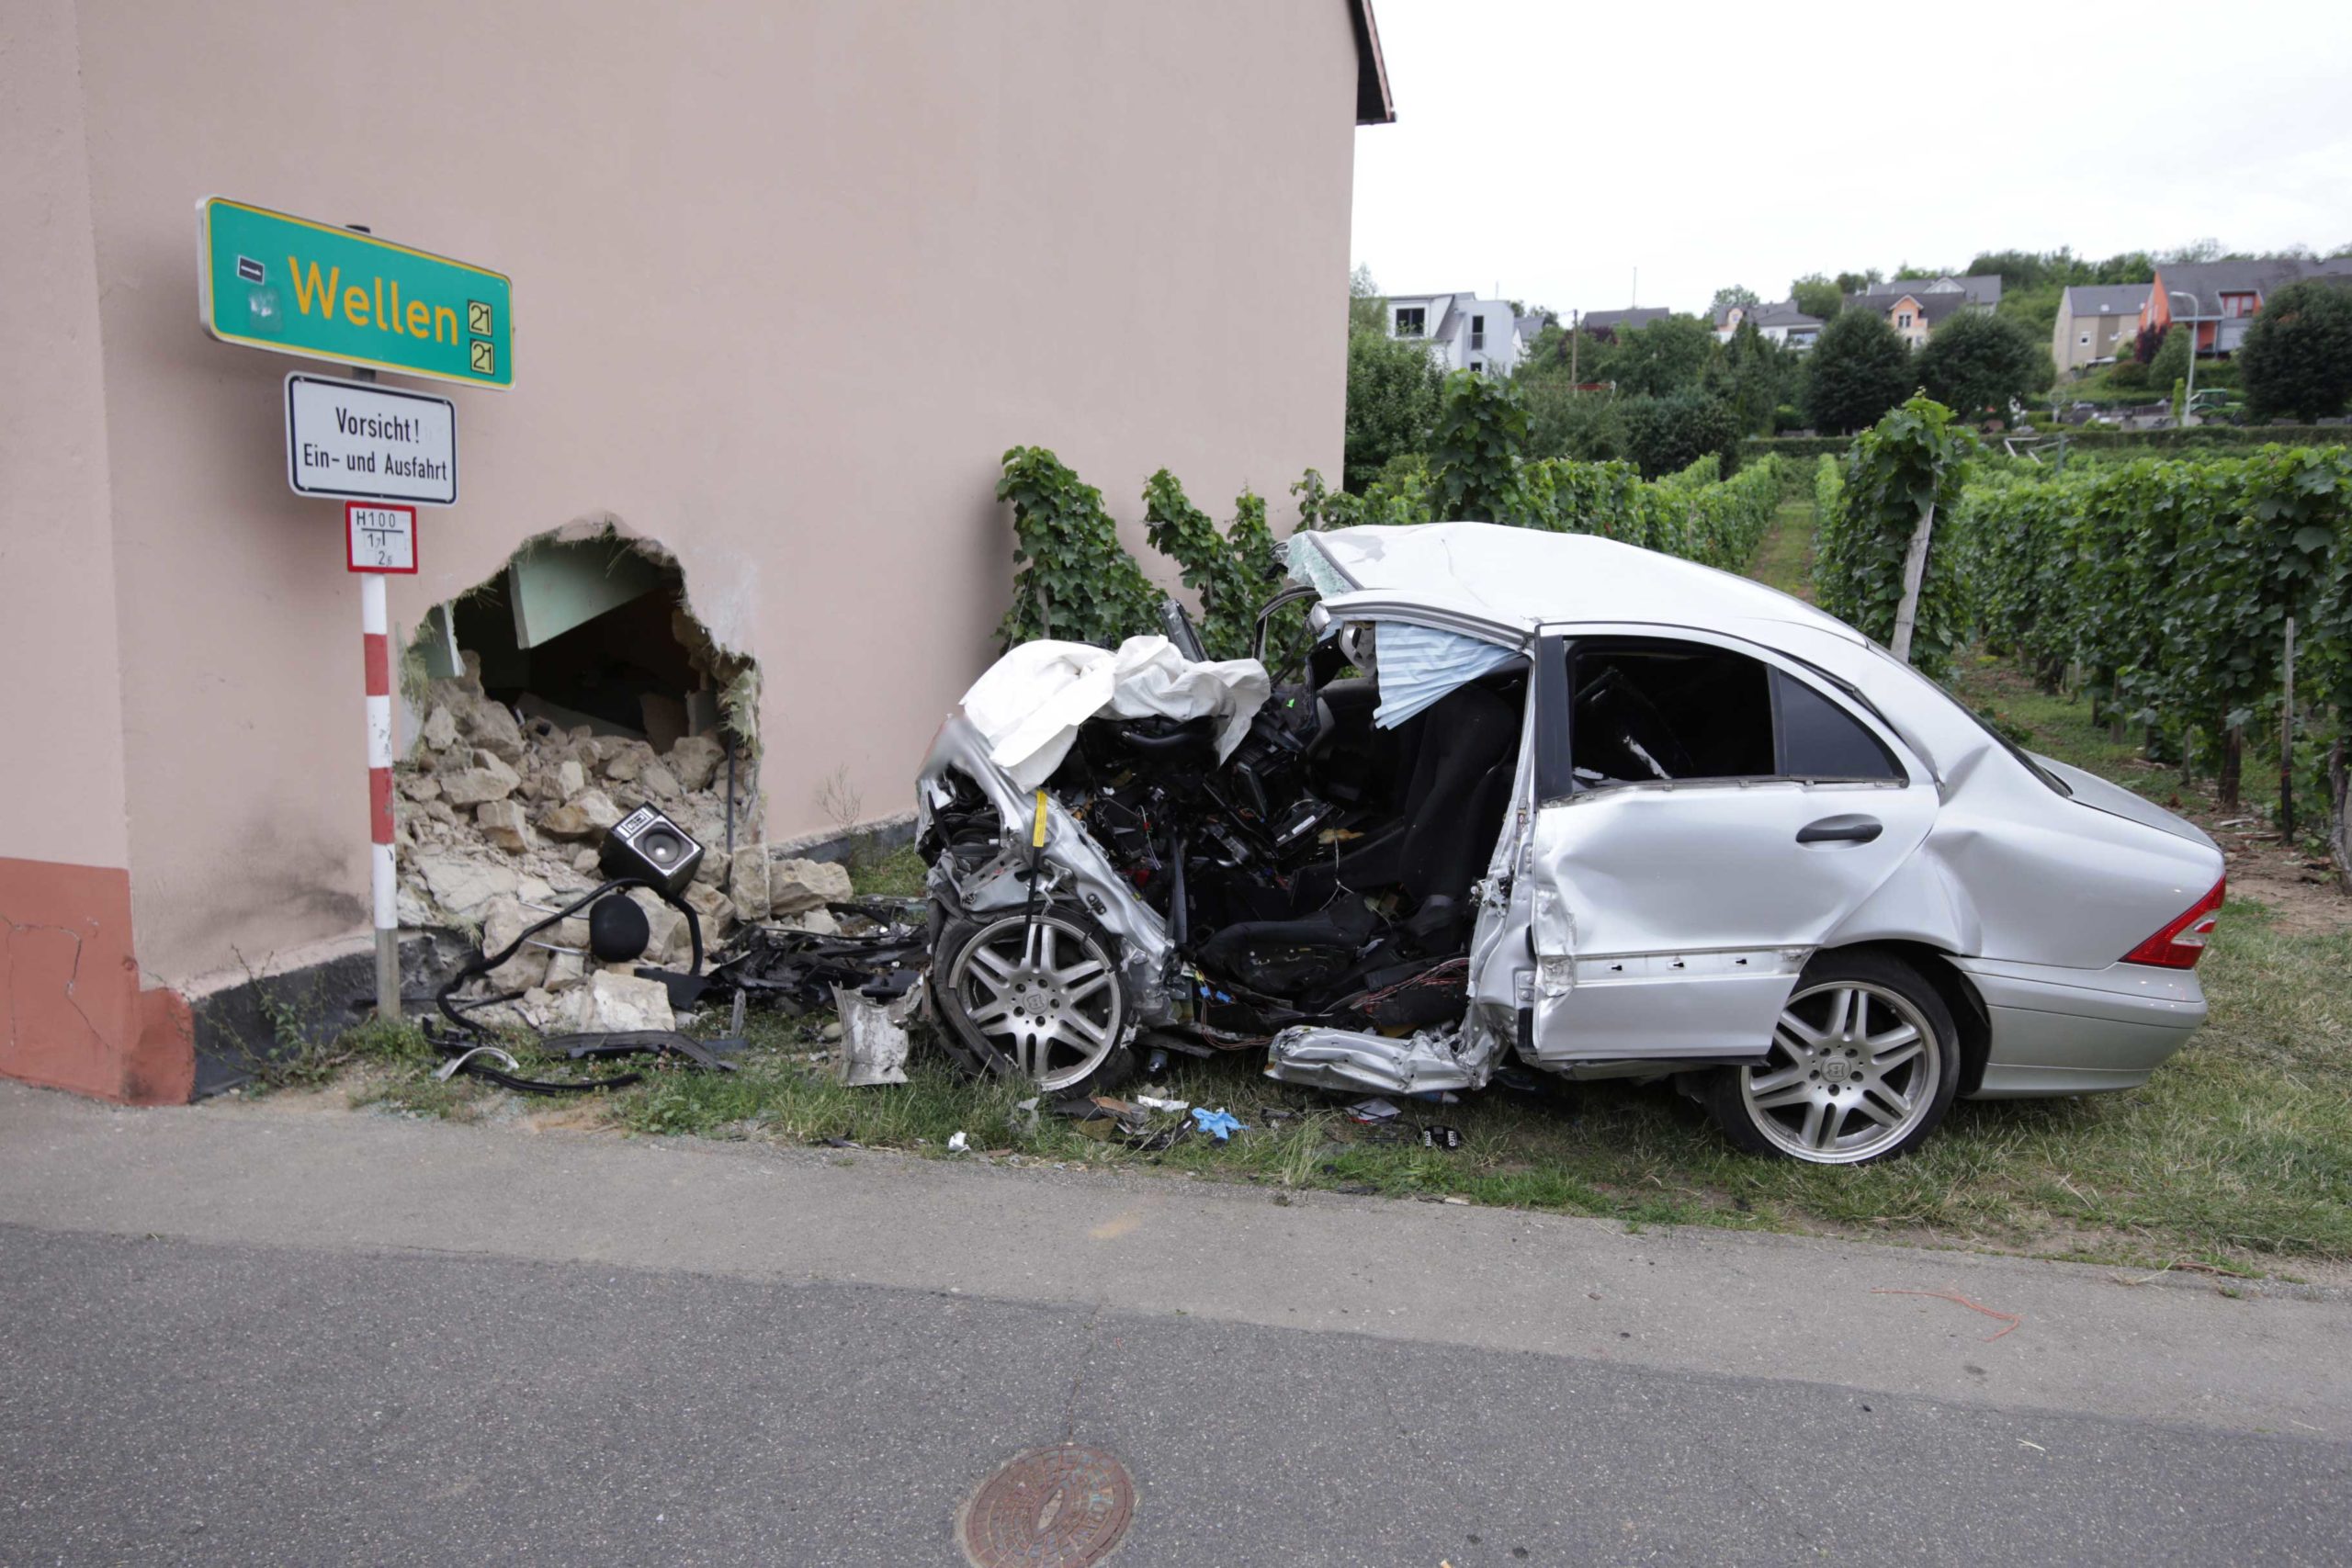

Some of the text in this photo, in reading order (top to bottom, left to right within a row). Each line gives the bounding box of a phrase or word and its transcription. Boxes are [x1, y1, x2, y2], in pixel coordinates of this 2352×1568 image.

[288, 255, 458, 346] Wellen
[470, 304, 491, 333] 21
[473, 343, 492, 372] 21
[335, 406, 420, 444] Vorsicht!
[303, 443, 447, 481] Ein- und Ausfahrt
[356, 511, 396, 528] H100
